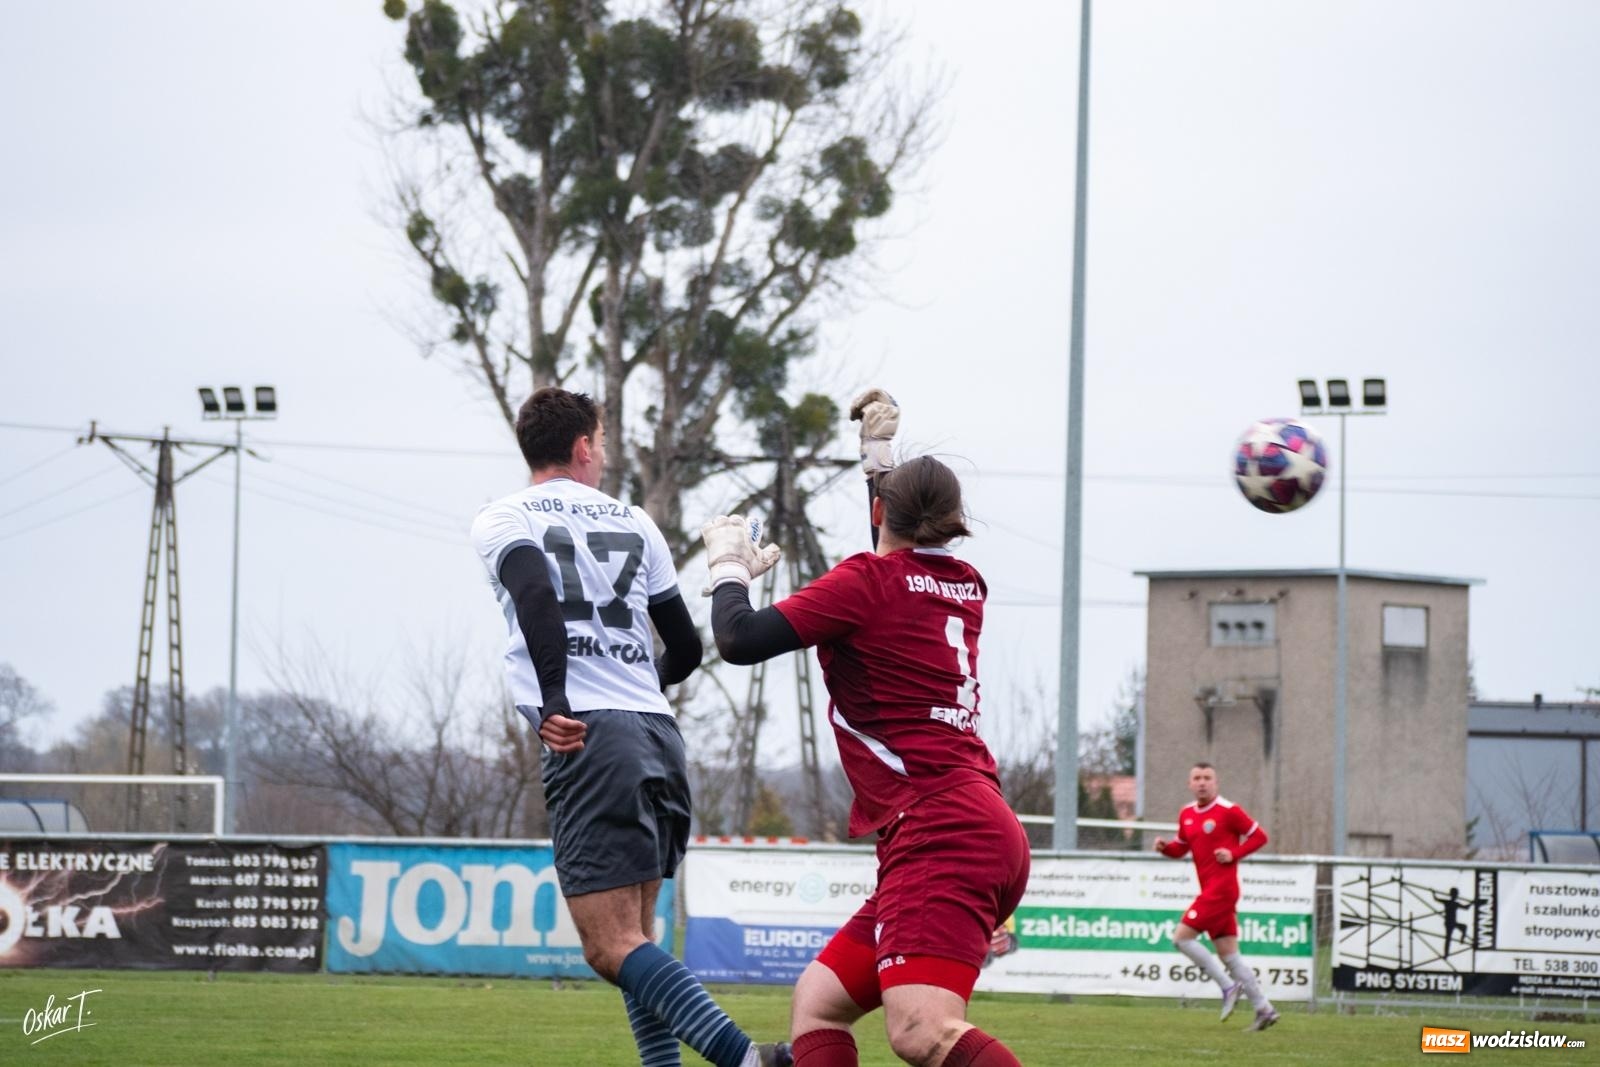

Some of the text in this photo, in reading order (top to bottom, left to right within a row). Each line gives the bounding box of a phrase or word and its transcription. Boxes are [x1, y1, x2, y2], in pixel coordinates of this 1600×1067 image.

[522, 498, 634, 520] 1908 NĘDZA
[543, 525, 645, 630] 17
[945, 615, 977, 713] 1
[16, 853, 155, 872] ELEKTRYCZNE
[232, 854, 260, 868] 603
[263, 854, 288, 869] 798
[290, 856, 319, 870] 967
[235, 874, 260, 886] 607
[730, 879, 877, 898] energy grou
[233, 897, 259, 909] 603
[262, 897, 288, 910] 798
[290, 898, 319, 910] 977
[338, 860, 665, 957] Jom
[1477, 872, 1494, 948] WYNAJEM
[173, 943, 317, 960] www.fiolka.com.pl
[1121, 964, 1161, 982] +48
[1269, 969, 1309, 986] 735
[1545, 959, 1569, 972] 538
[1573, 961, 1598, 974] 300
[1355, 972, 1462, 990] PNG SYSTEM
